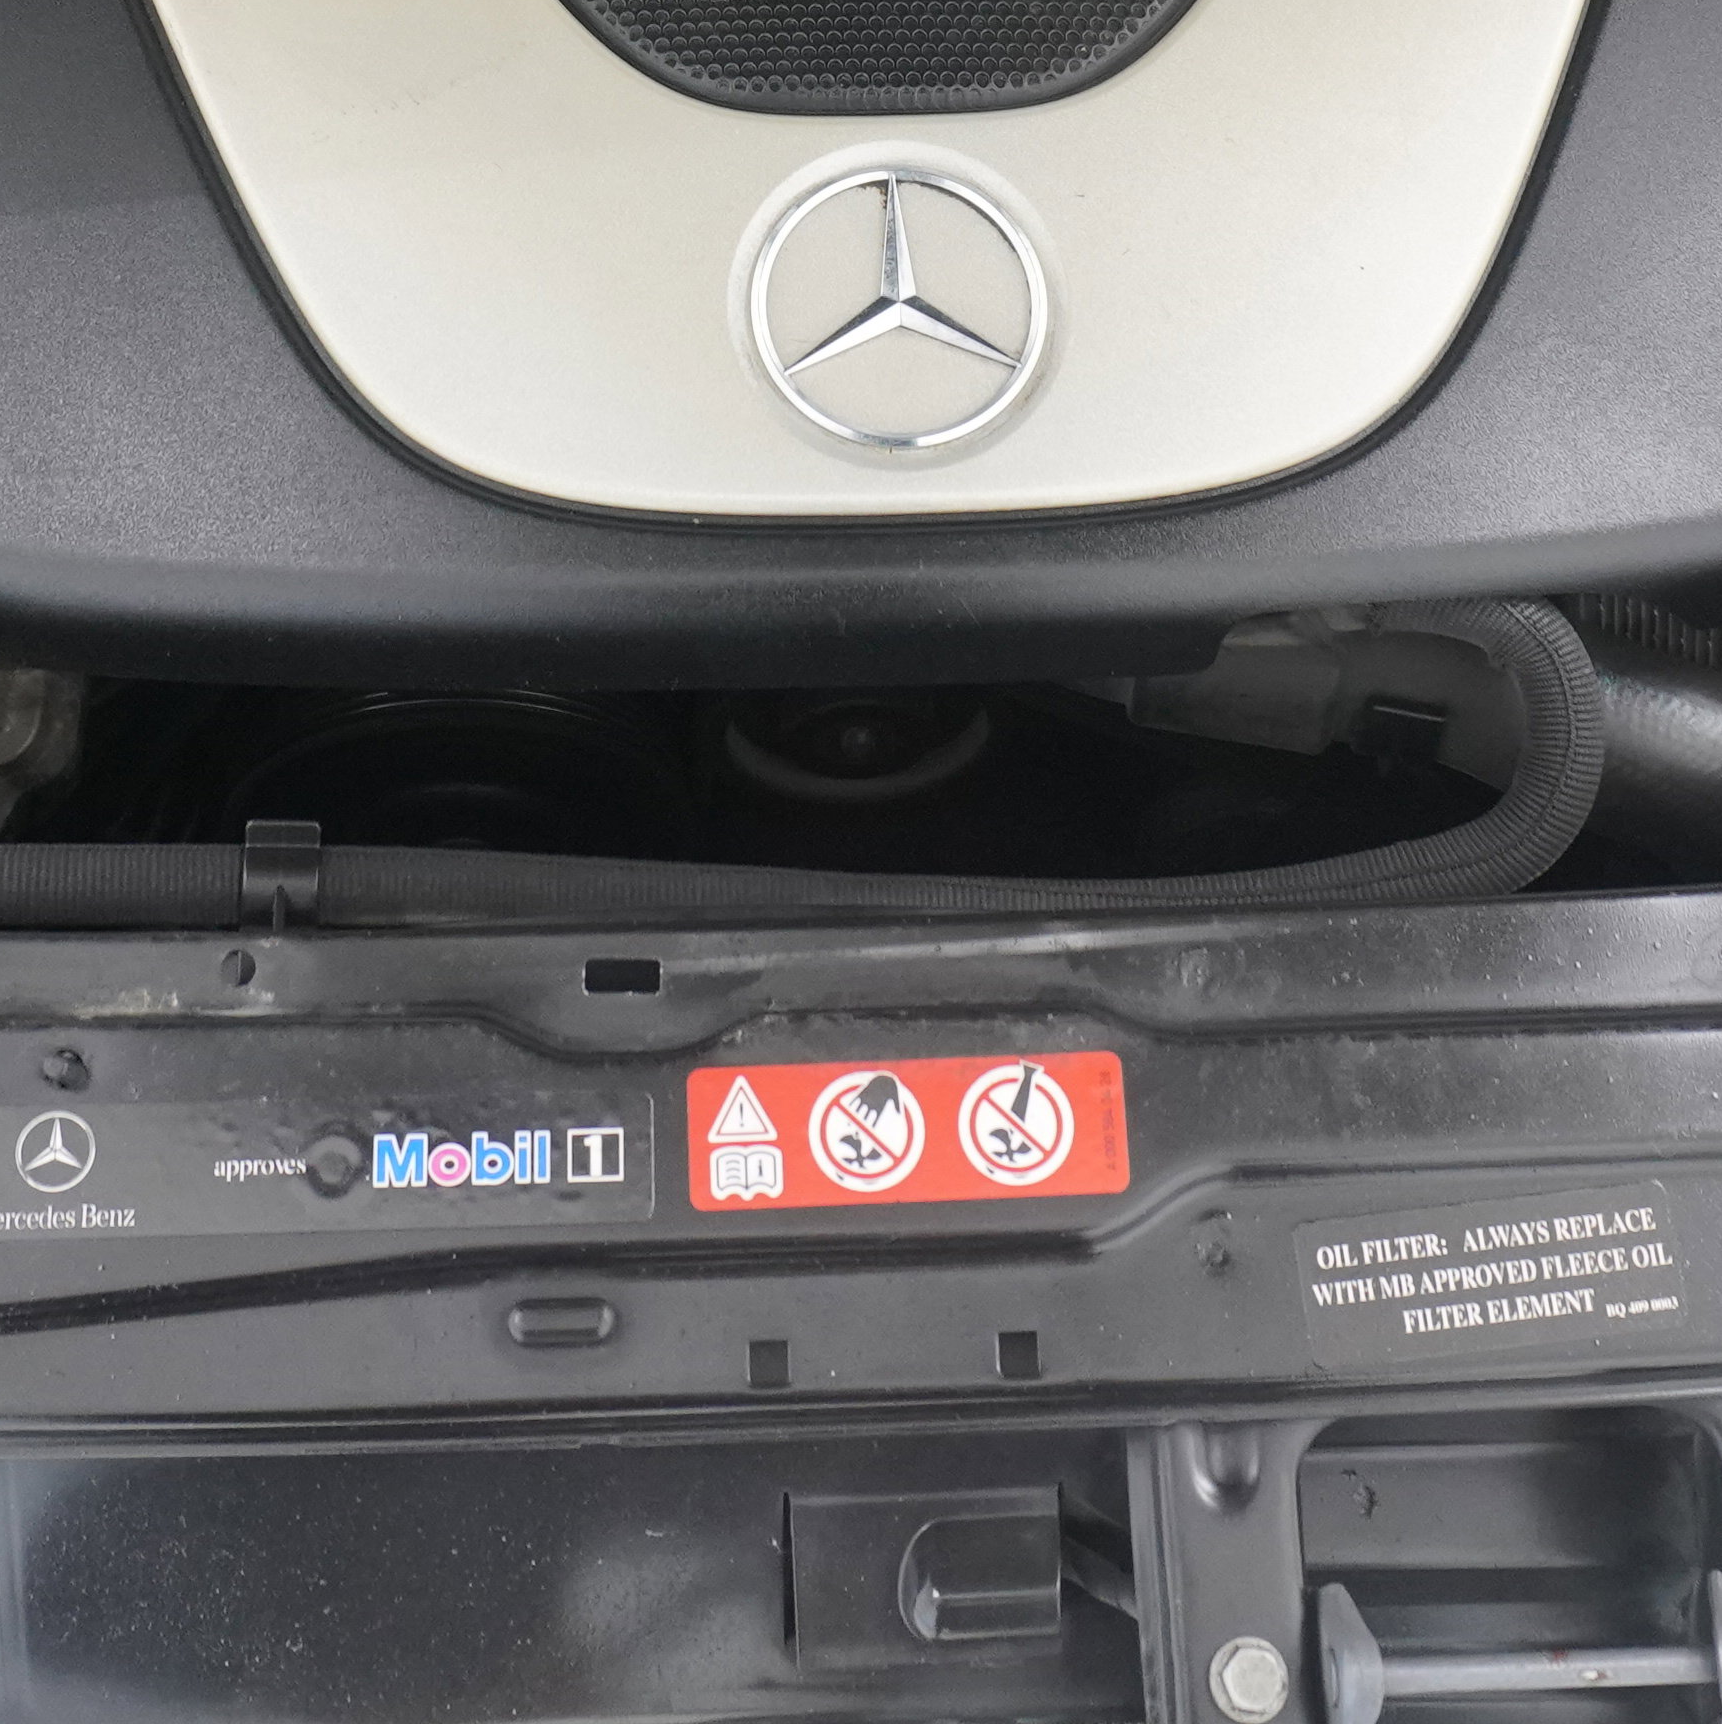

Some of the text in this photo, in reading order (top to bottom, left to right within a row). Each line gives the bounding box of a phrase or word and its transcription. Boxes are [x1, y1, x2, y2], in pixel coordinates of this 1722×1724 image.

[213, 1155, 307, 1182] approves
[373, 1130, 551, 1188] Mobil
[81, 1203, 136, 1229] Benz
[1316, 1206, 1657, 1270] OIL FILTER: ALWAYS REPLACE
[1311, 1242, 1673, 1307] WITH MB APPROVED FLEECE OIL
[1402, 1288, 1596, 1335] FILTER ELEMENT
[1605, 1302, 1627, 1318] BQ
